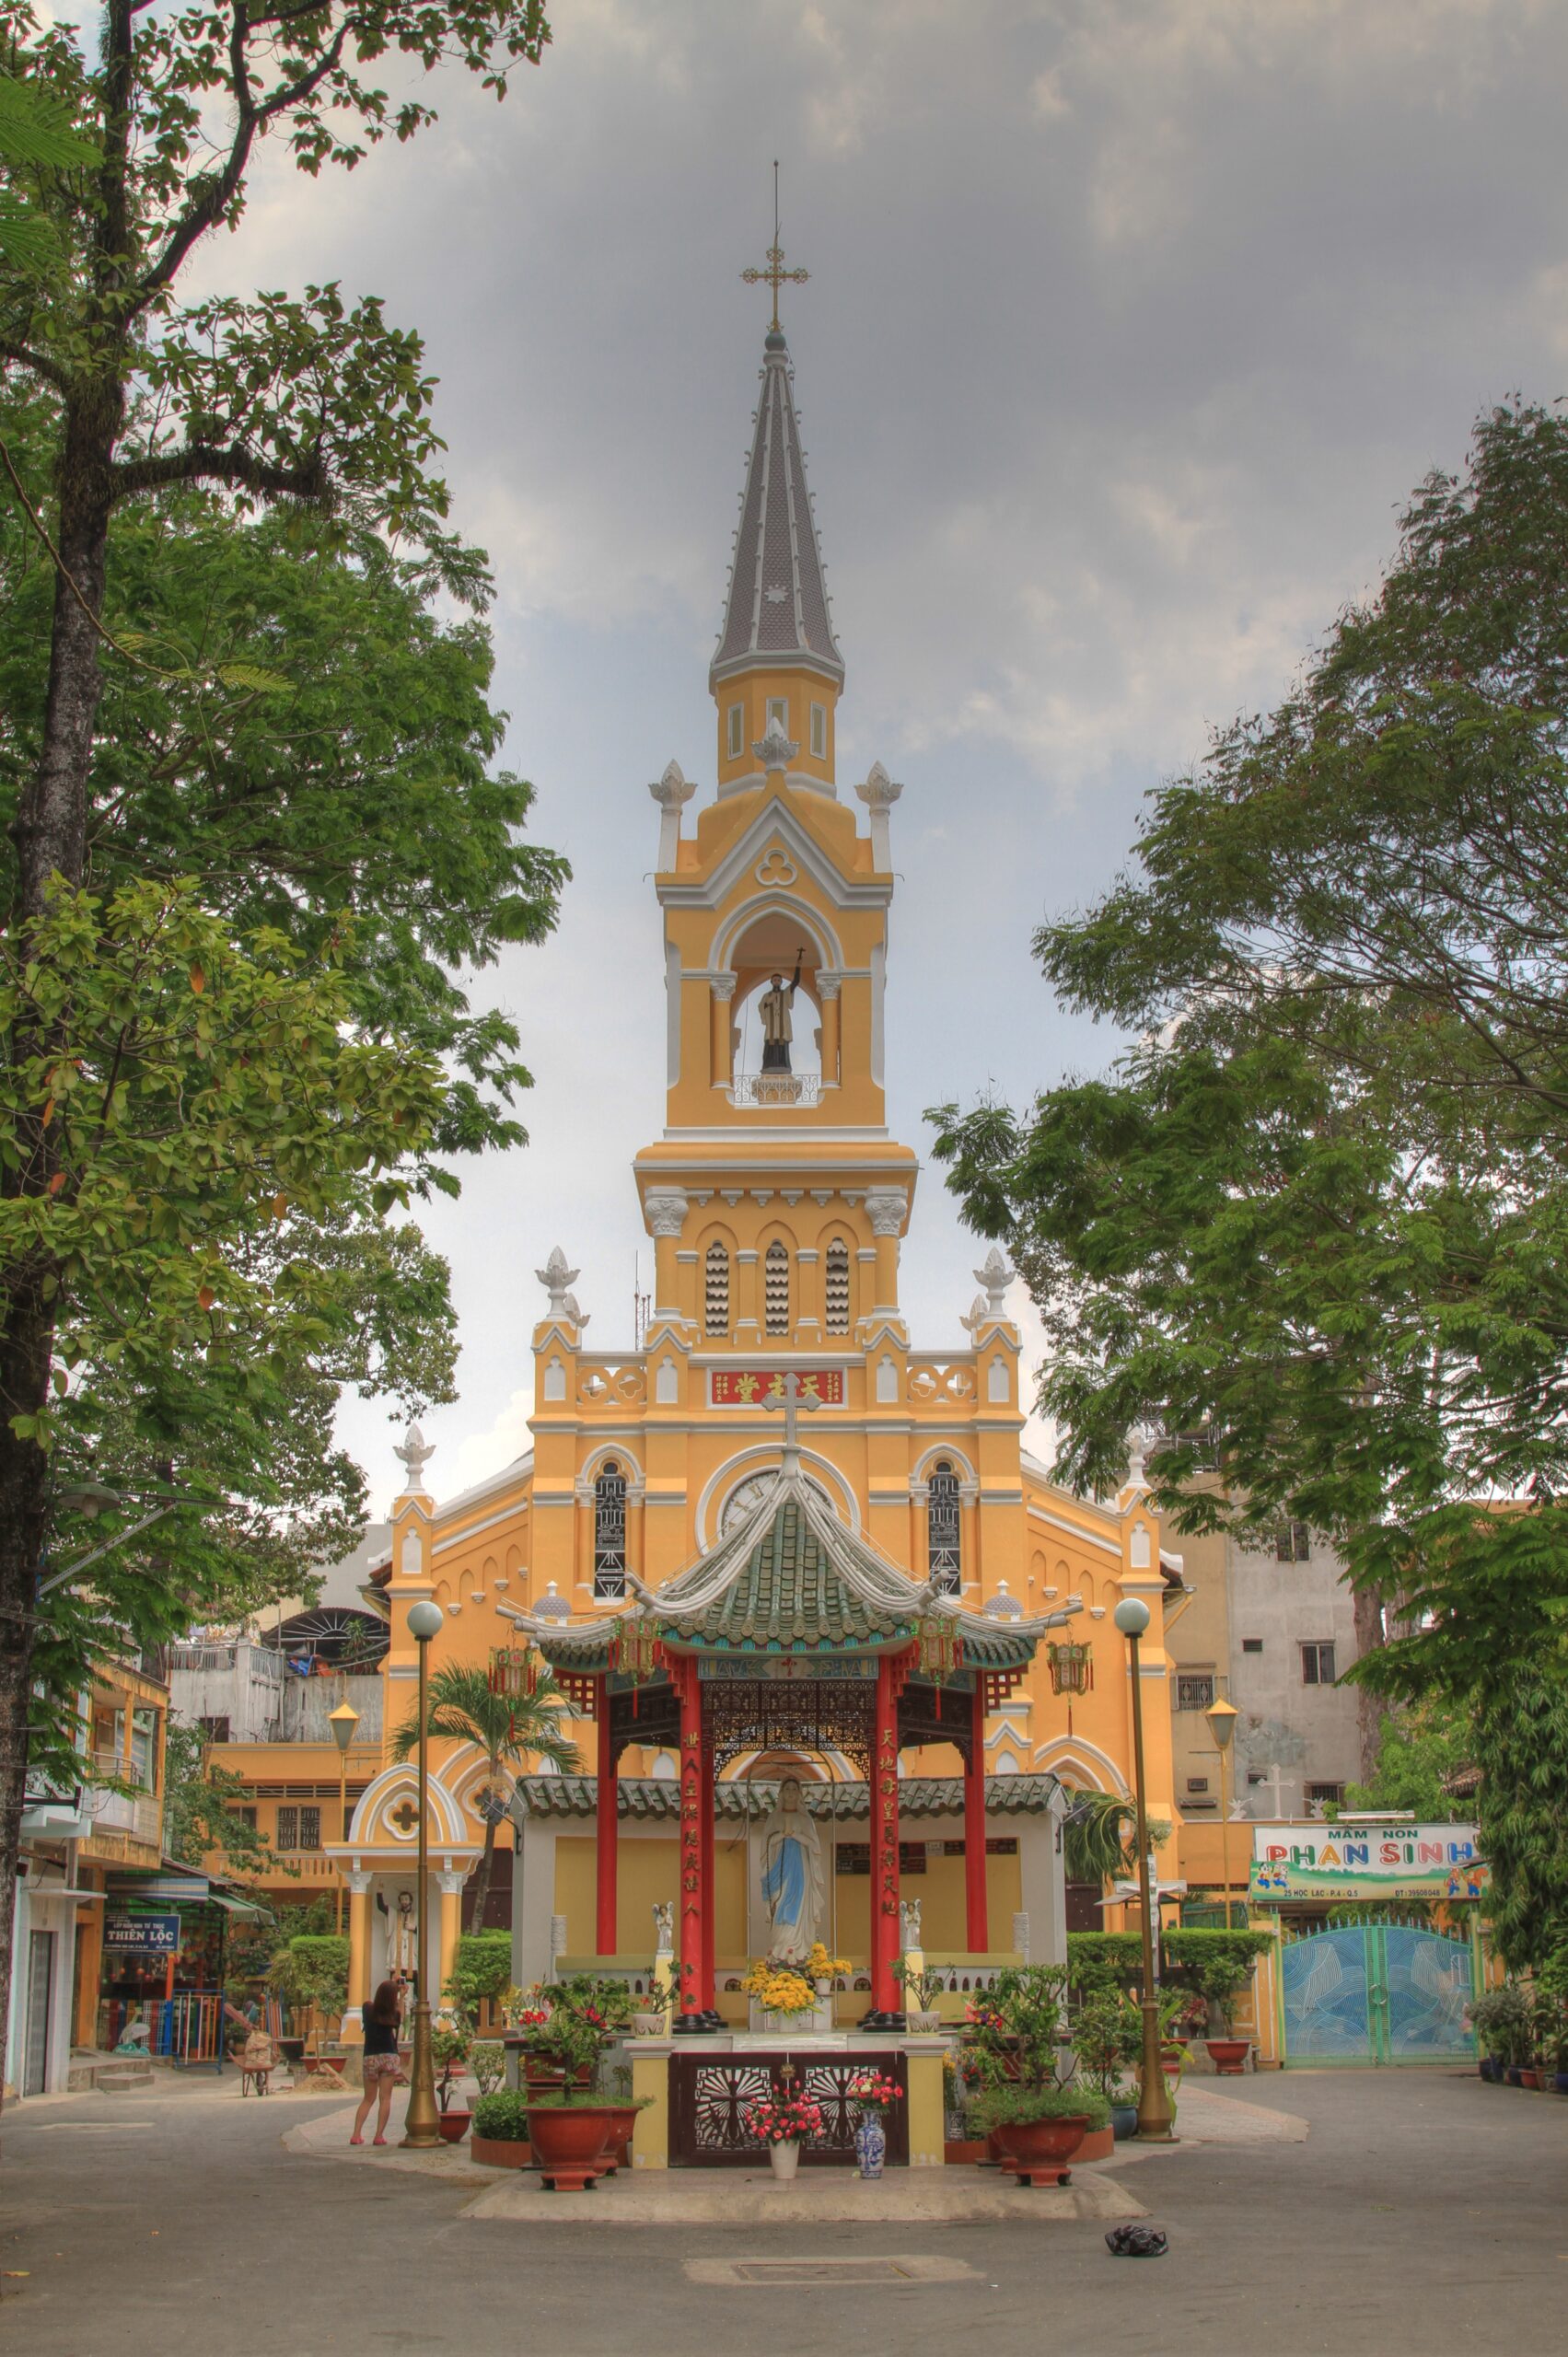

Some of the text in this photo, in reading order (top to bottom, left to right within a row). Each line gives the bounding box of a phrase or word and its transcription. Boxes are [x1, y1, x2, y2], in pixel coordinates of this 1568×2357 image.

[1383, 1829, 1418, 1839] NON
[1266, 1842, 1473, 1865] PHAN SINH
[108, 1929, 174, 1944] THIÊN LỘC
